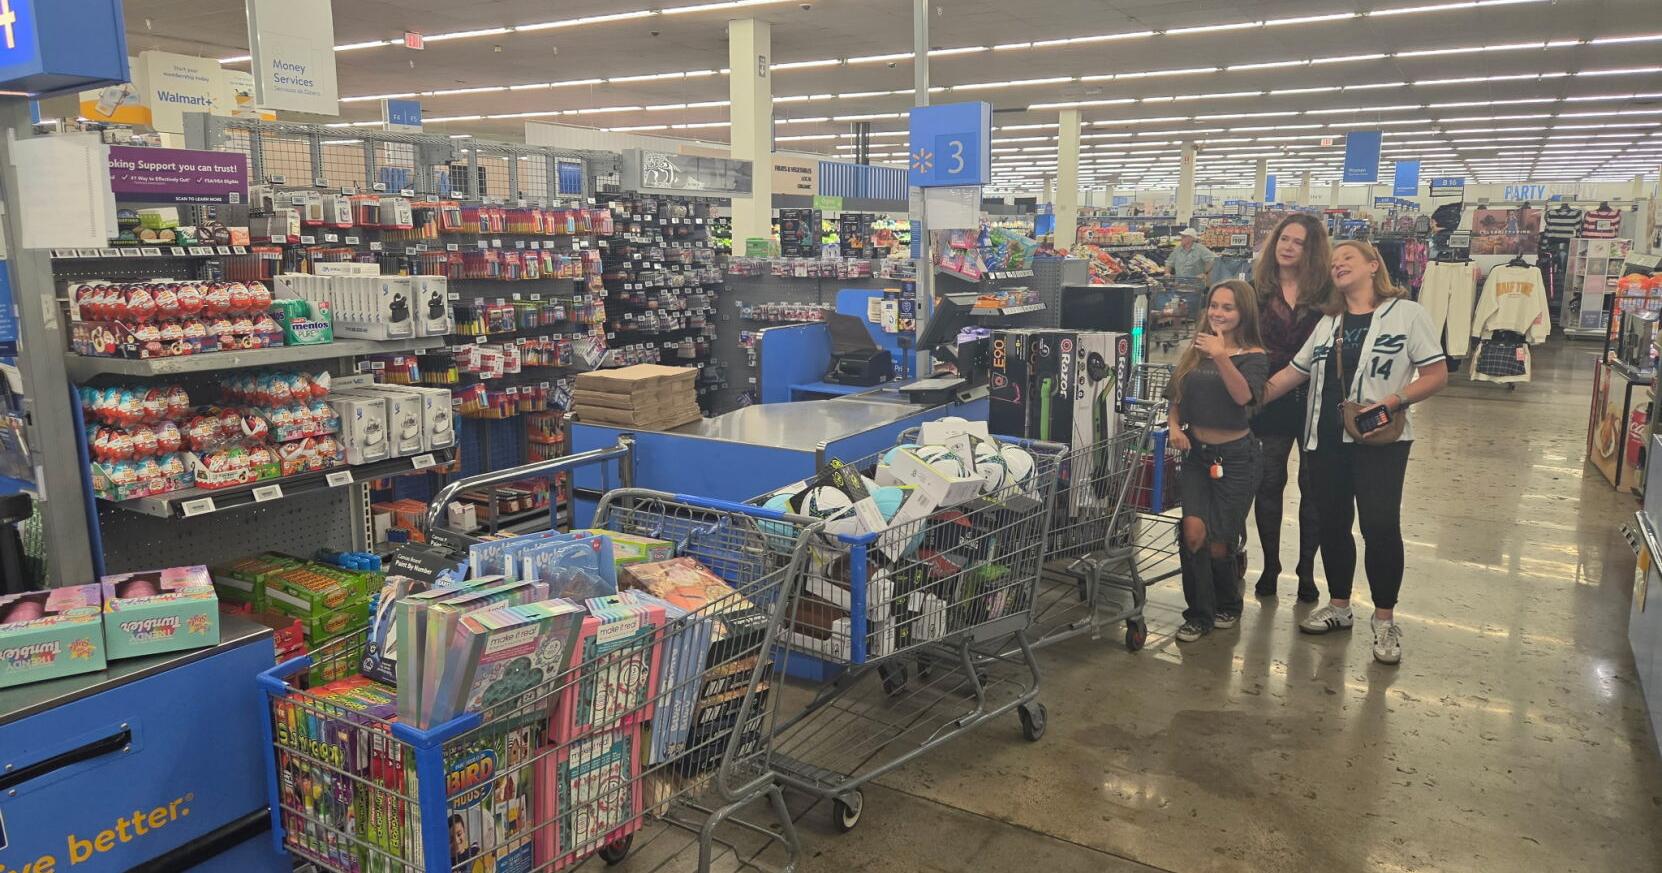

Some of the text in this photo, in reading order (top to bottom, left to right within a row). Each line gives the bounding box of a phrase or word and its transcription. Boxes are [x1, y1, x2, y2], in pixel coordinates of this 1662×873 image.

[272, 59, 306, 74] Money
[273, 73, 314, 87] Services
[158, 90, 213, 107] Walmart+
[948, 140, 965, 174] 3
[138, 160, 176, 171] Support
[179, 164, 196, 172] you
[214, 164, 238, 173] trust!
[1504, 185, 1546, 200] PARTY
[291, 322, 329, 332] mentos
[993, 340, 1005, 368] E90
[1370, 356, 1394, 380] 14
[1060, 353, 1071, 400] Razor
[1116, 356, 1126, 411] Razor
[396, 560, 408, 568] Paint
[414, 566, 433, 576] Number
[120, 616, 181, 633] Tumbler
[600, 625, 618, 636] make
[490, 633, 514, 646] make
[446, 756, 495, 796] BIRD
